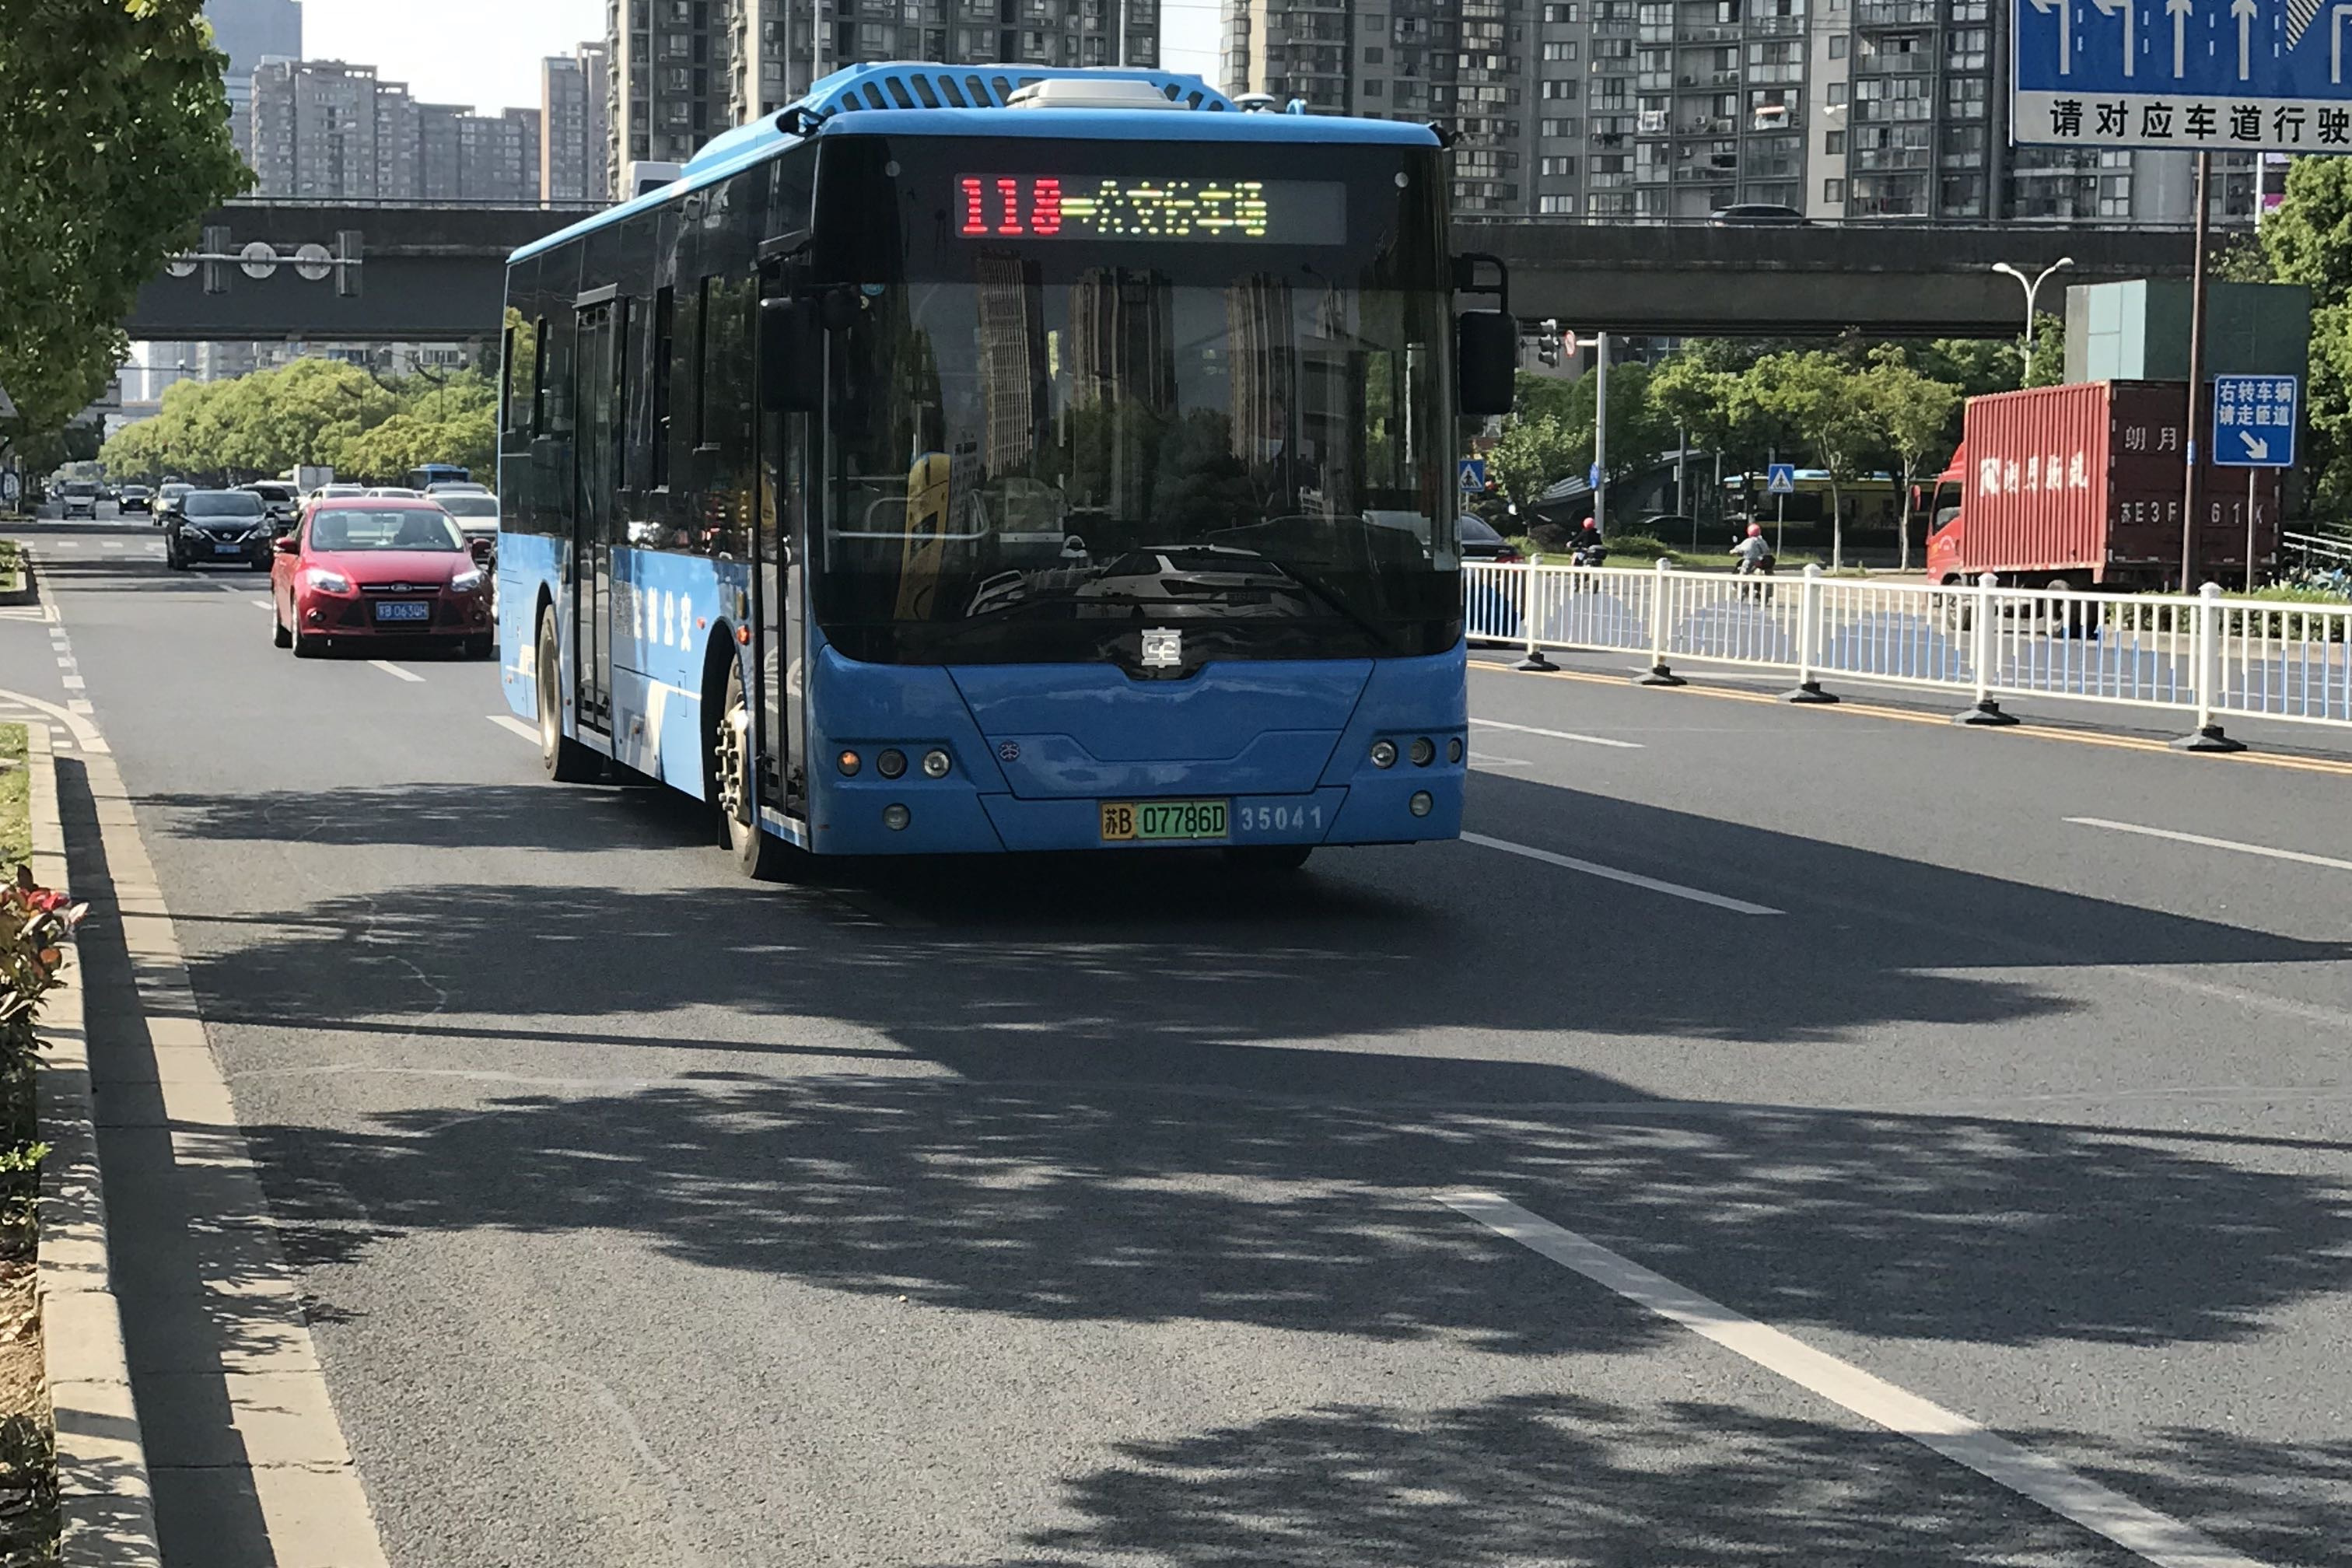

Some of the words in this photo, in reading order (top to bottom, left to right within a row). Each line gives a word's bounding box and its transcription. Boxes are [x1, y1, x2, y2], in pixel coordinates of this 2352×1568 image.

[2049, 99, 2350, 144] 请对应车道行驶
[961, 179, 1061, 233] 118
[2219, 380, 2293, 403] 右转车辆
[1241, 806, 1322, 831] 35041
